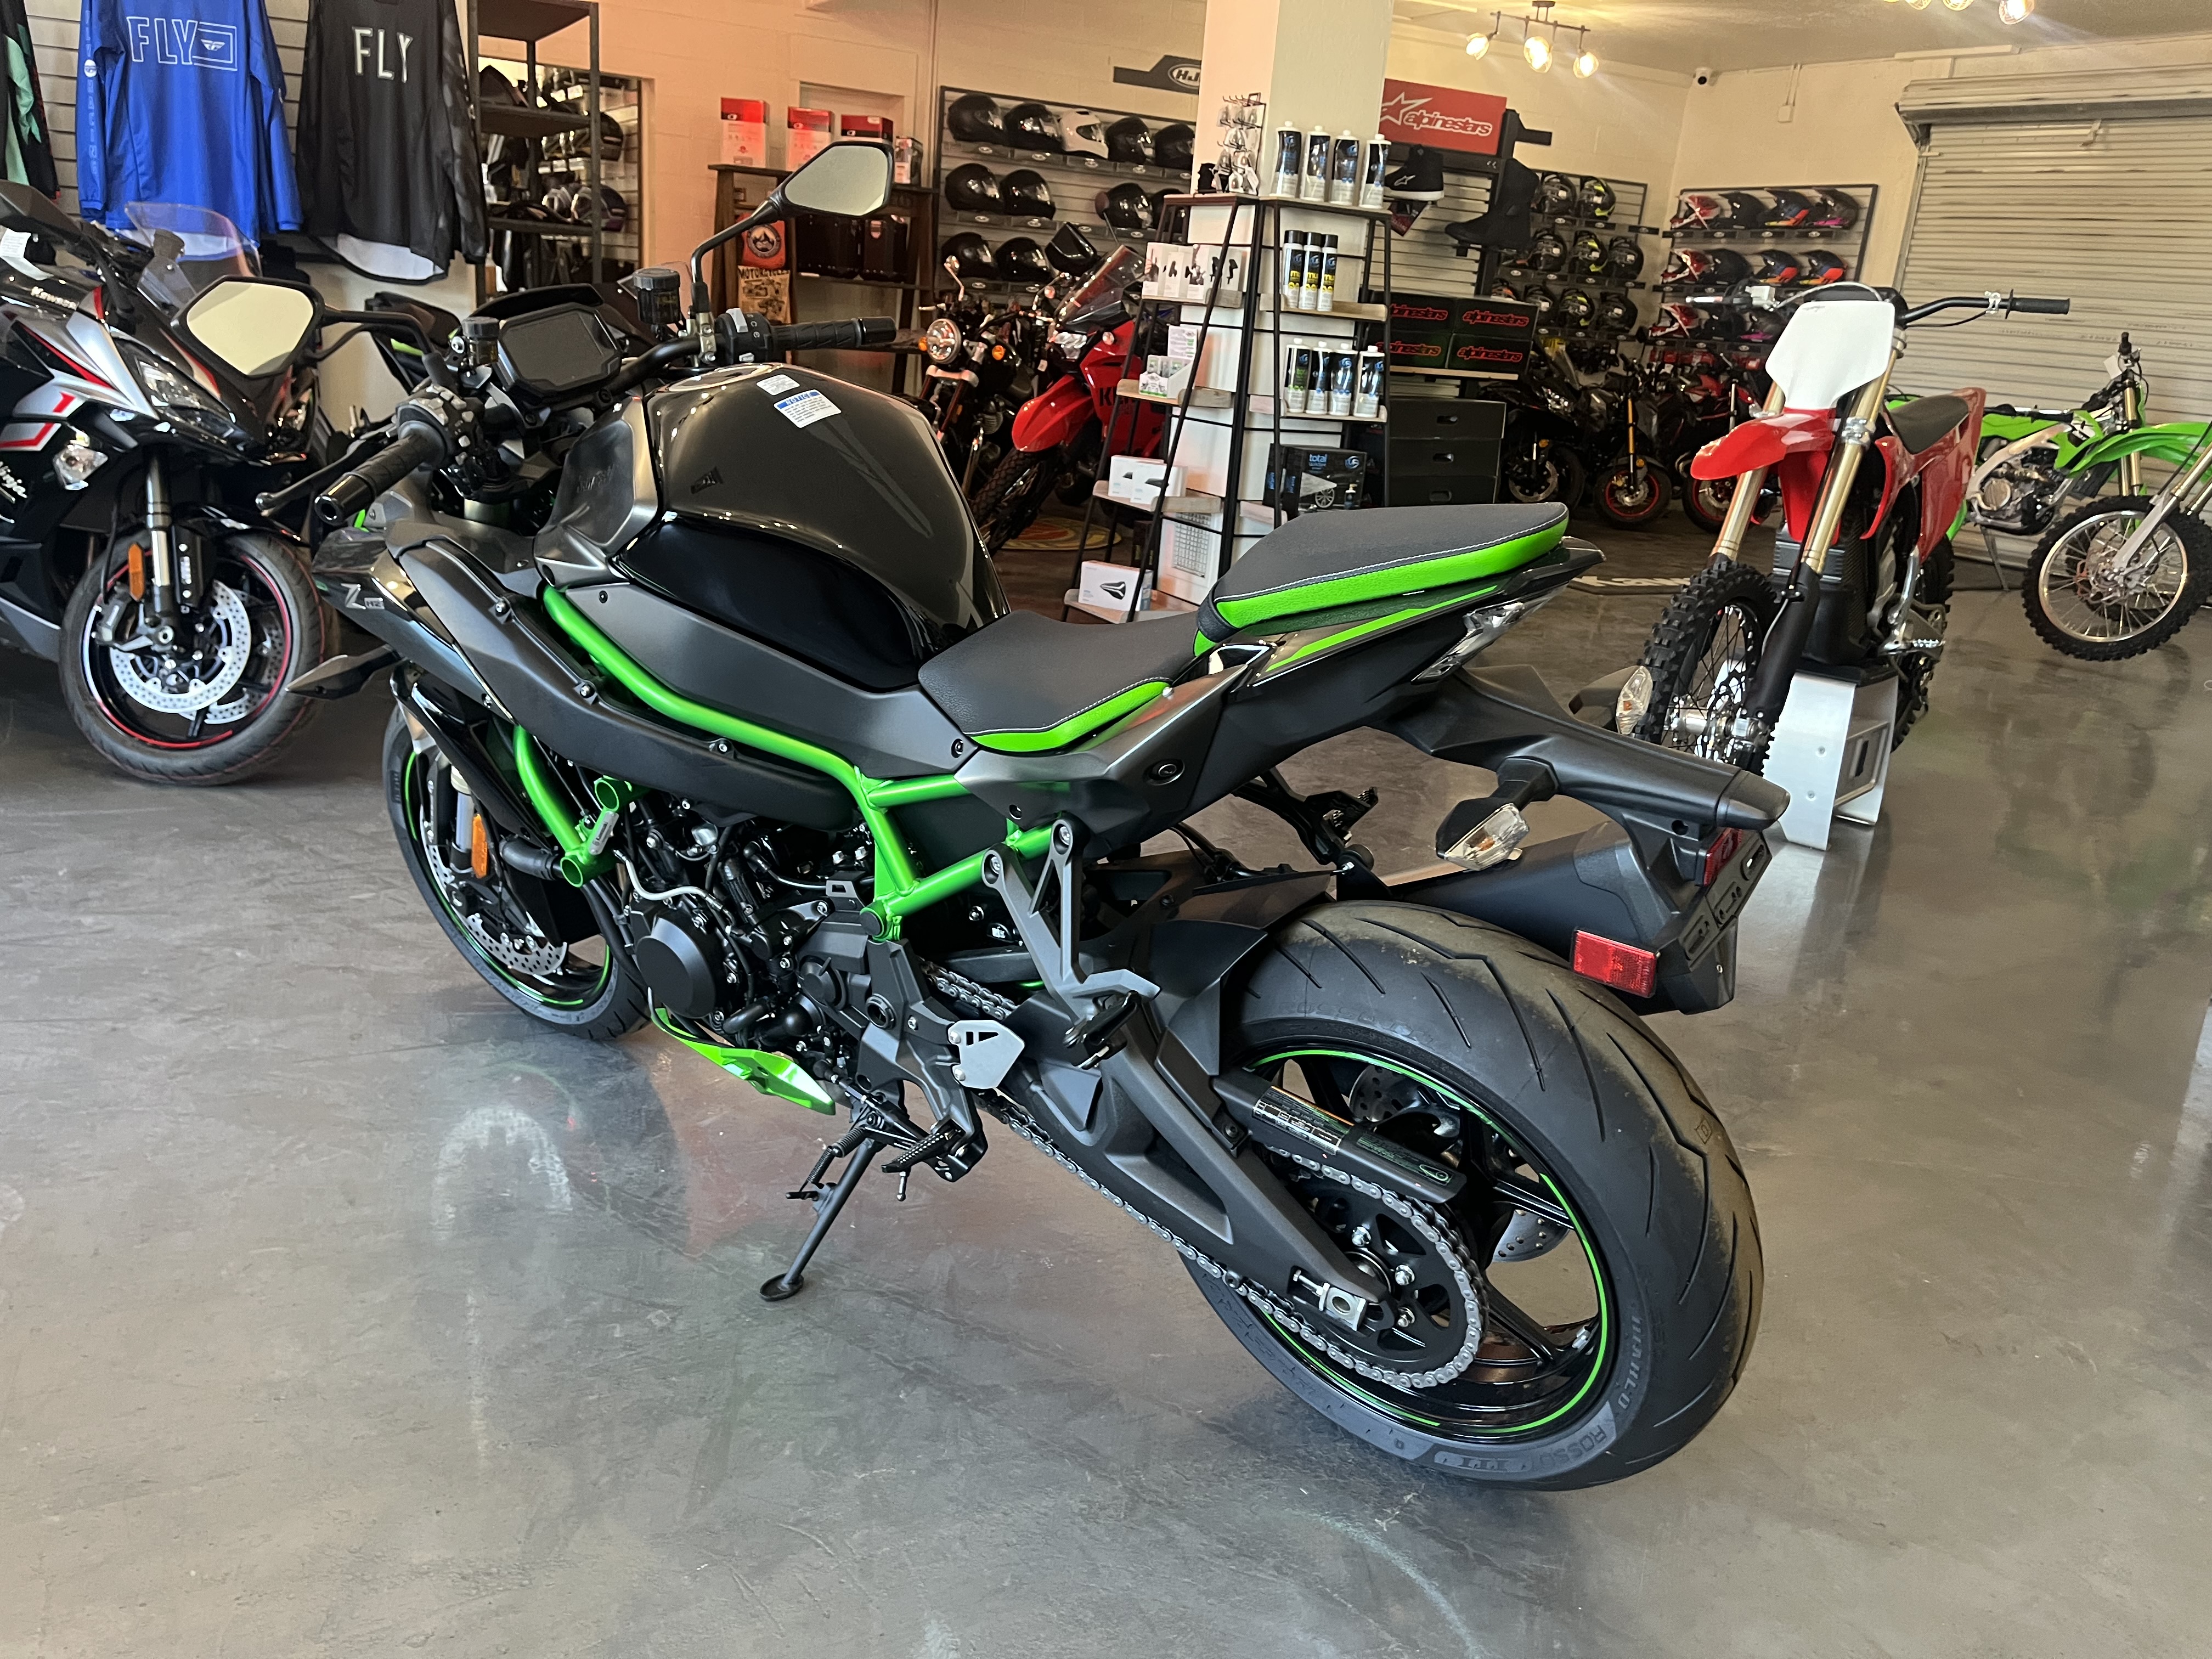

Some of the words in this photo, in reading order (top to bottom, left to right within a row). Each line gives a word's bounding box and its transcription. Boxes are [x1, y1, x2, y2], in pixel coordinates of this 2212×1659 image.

[126, 16, 198, 65] FLY
[352, 26, 413, 83] FLY
[1176, 69, 1201, 82] HJ
[1403, 109, 1493, 137] alpinestars
[1390, 303, 1448, 321] lpinestars
[1462, 309, 1530, 327] alpinestars
[1457, 346, 1523, 363] alpinestars
[785, 392, 812, 405] NOTICE
[1309, 454, 1327, 462] total
[1539, 1424, 1607, 1470] ROSSO
